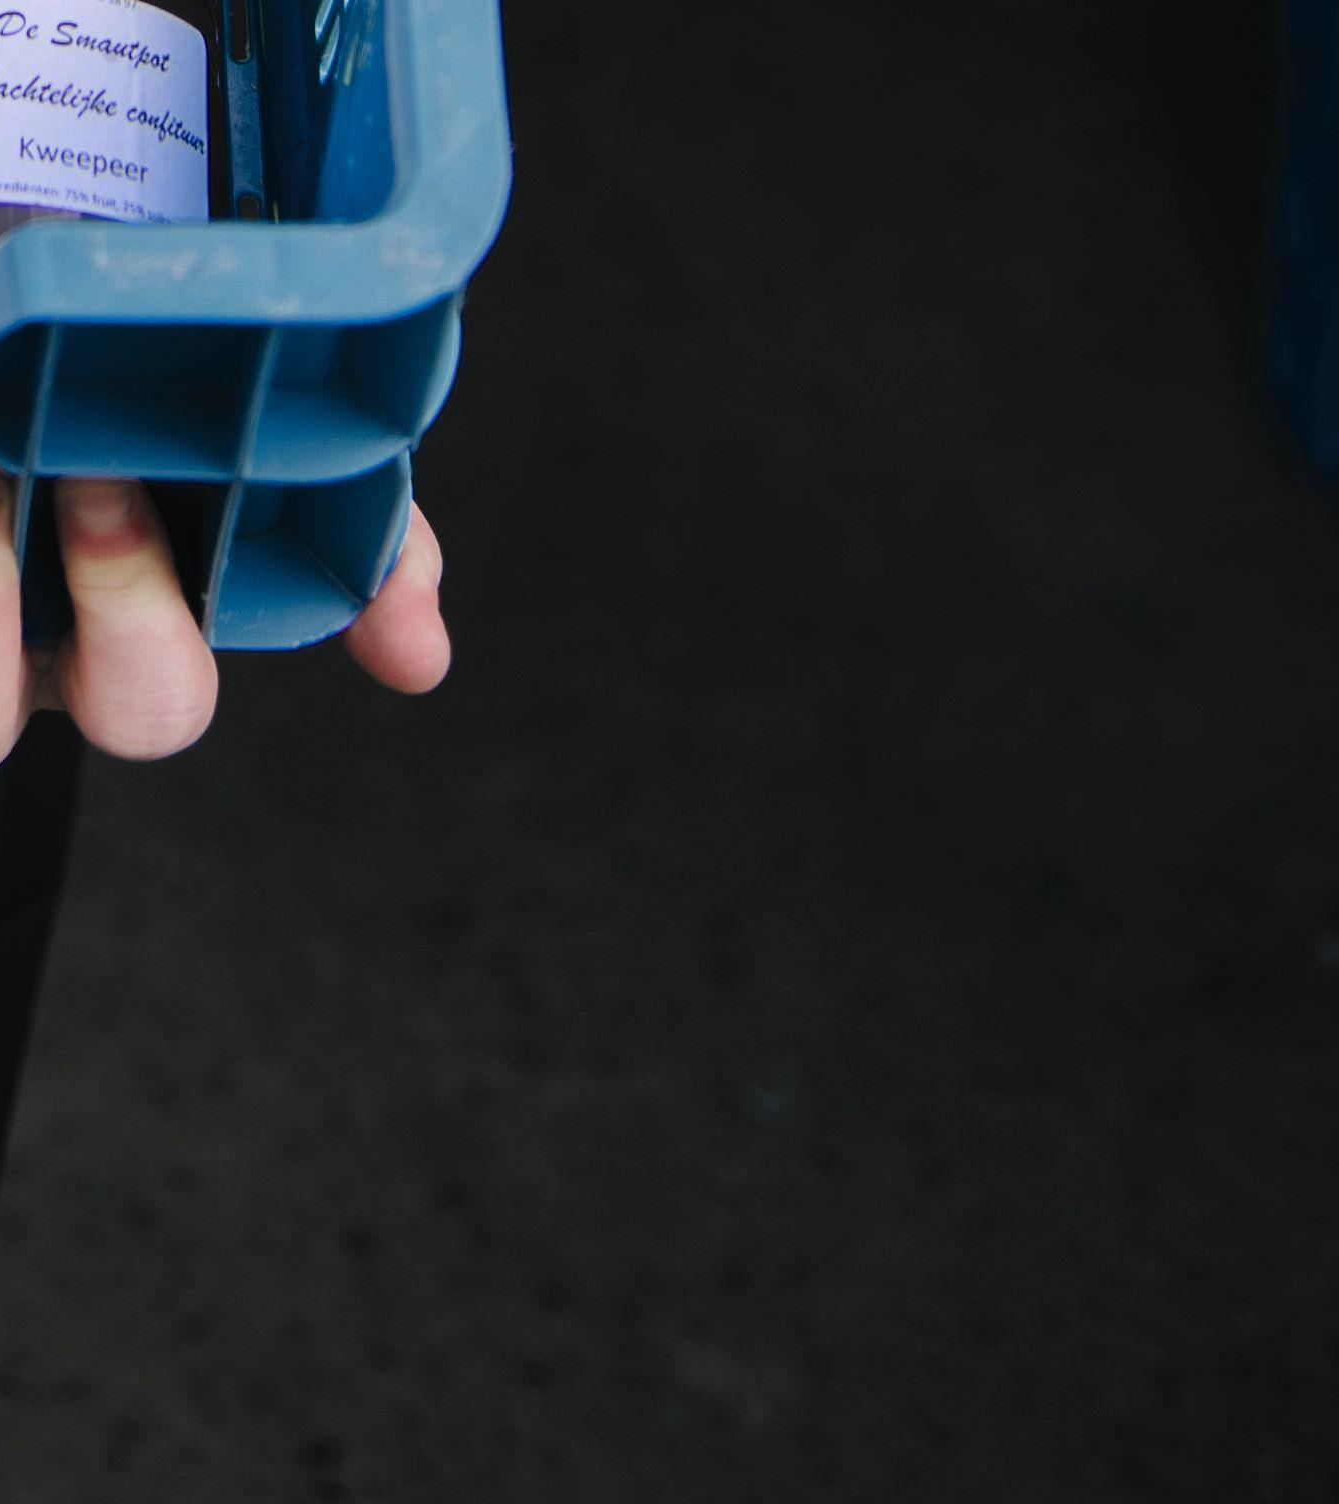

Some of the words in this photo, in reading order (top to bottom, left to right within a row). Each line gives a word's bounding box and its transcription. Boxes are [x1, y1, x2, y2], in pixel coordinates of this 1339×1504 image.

[50, 21, 171, 72] Smautpot
[125, 105, 207, 155] confituur
[19, 137, 149, 183] Kweepeer
